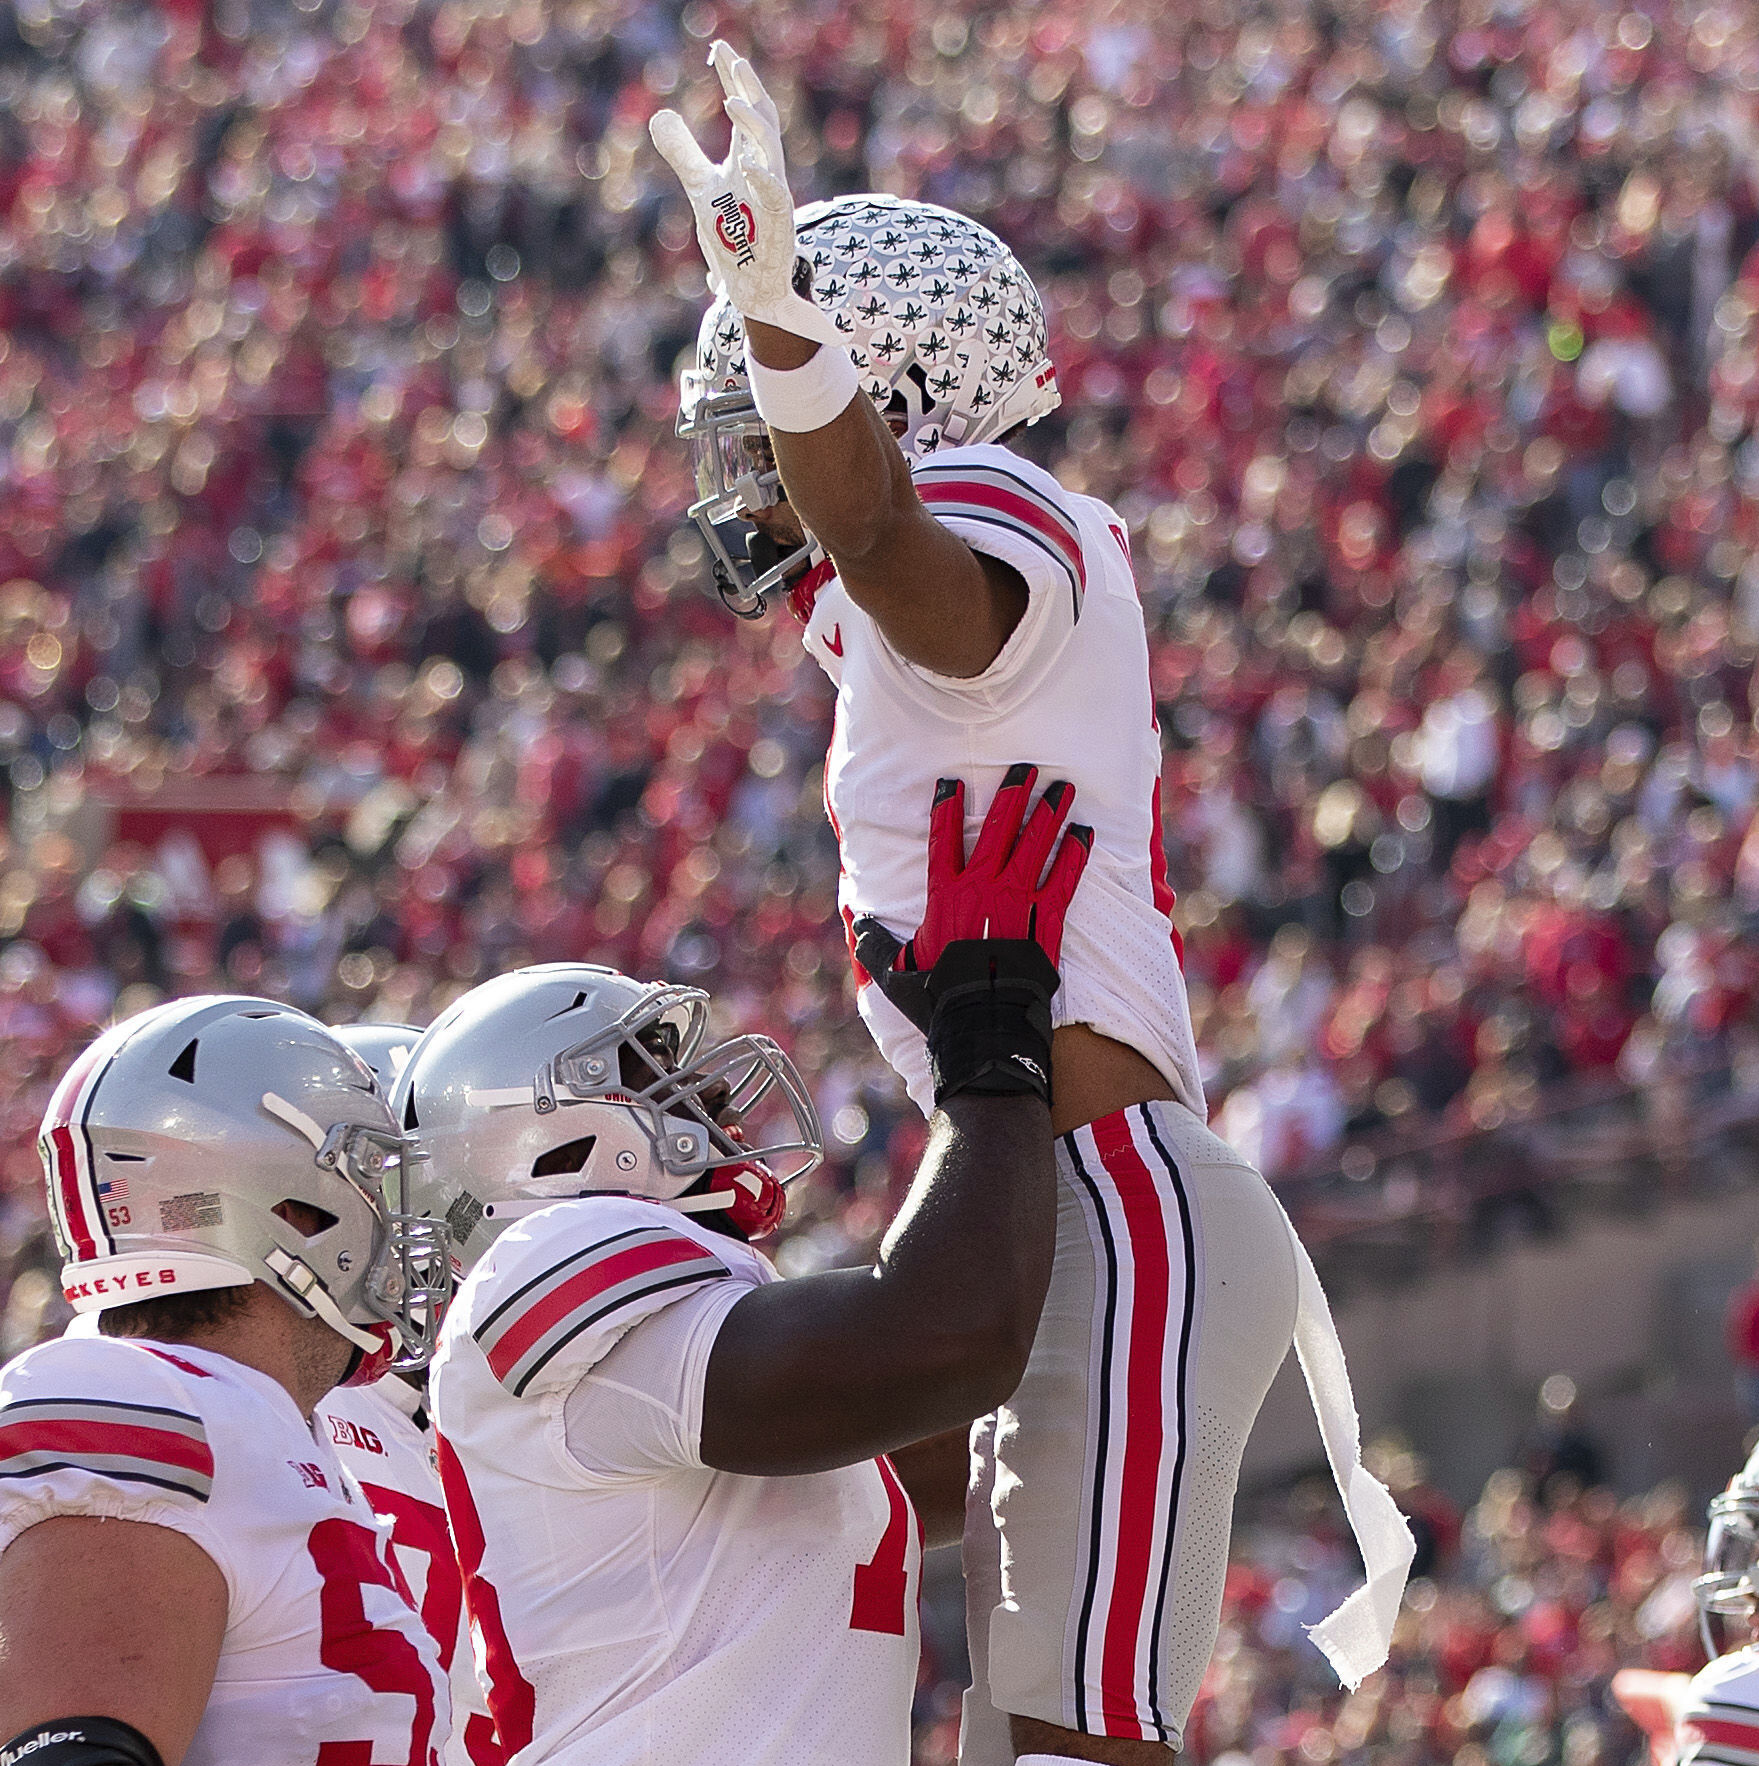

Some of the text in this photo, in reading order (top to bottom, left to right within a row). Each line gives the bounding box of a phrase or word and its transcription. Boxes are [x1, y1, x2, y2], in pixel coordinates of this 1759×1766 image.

[711, 192, 756, 271] OHIO STATE
[108, 1206, 131, 1227] 53
